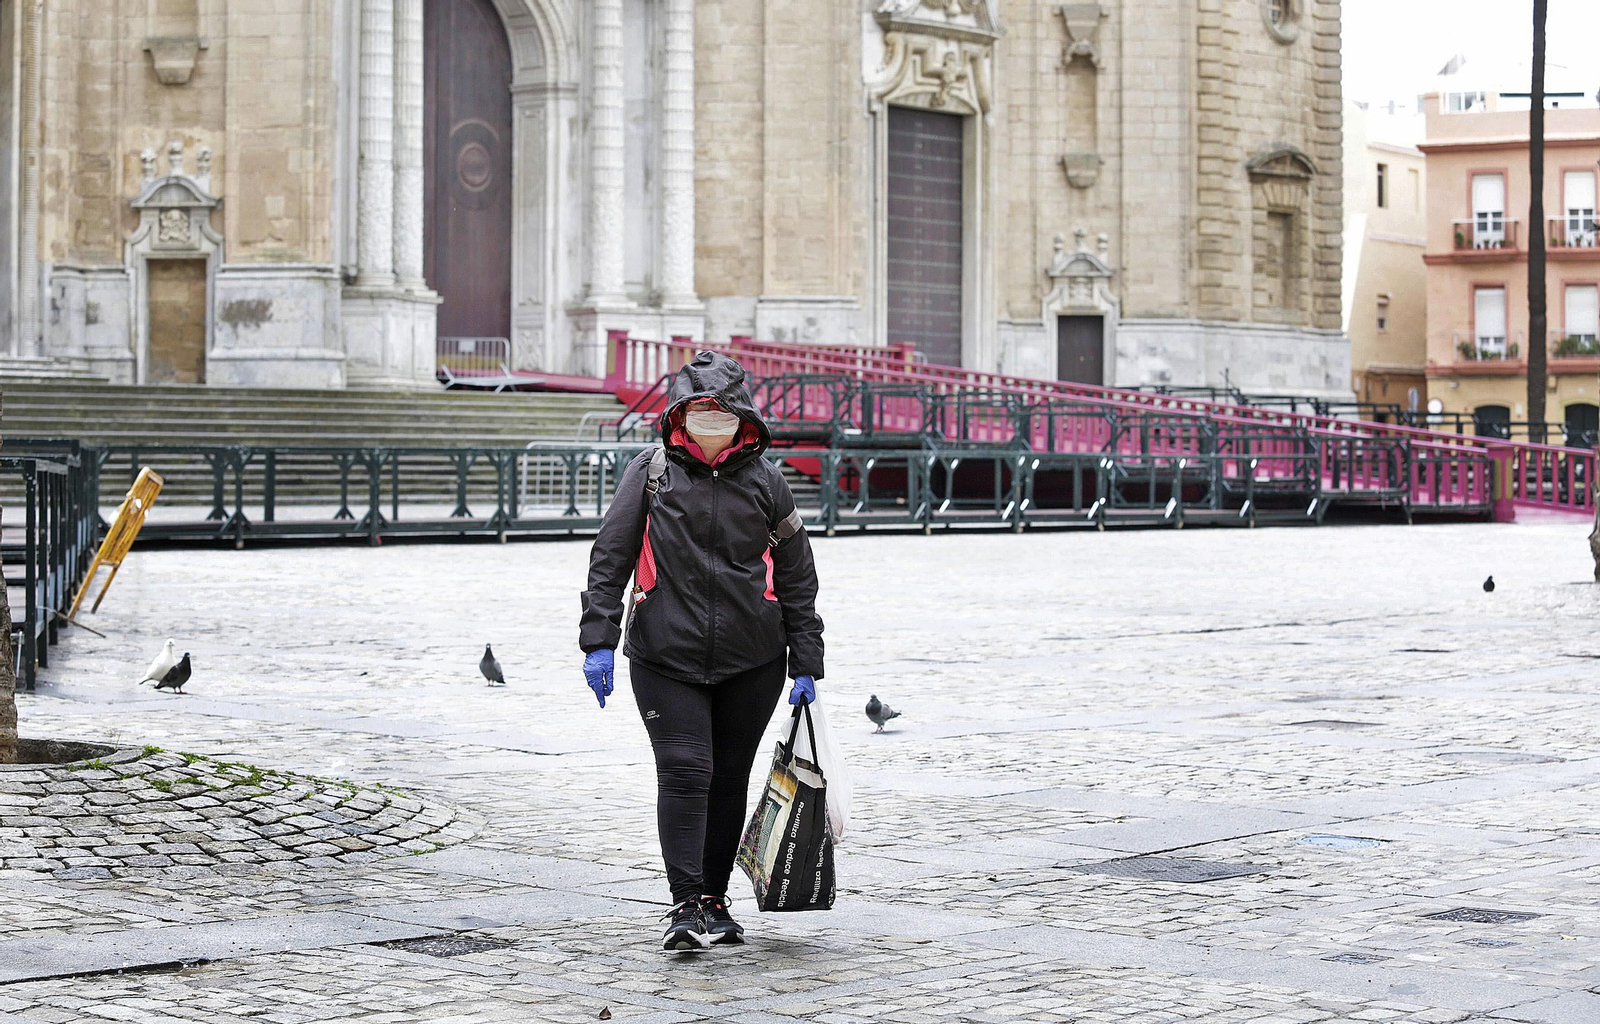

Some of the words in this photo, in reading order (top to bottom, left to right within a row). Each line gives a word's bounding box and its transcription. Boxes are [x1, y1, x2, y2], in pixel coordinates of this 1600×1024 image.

[791, 801, 804, 838] Reutiliza
[784, 842, 796, 875] Reduce
[777, 878, 790, 907] Recicla
[810, 871, 821, 903] Reutiliza
